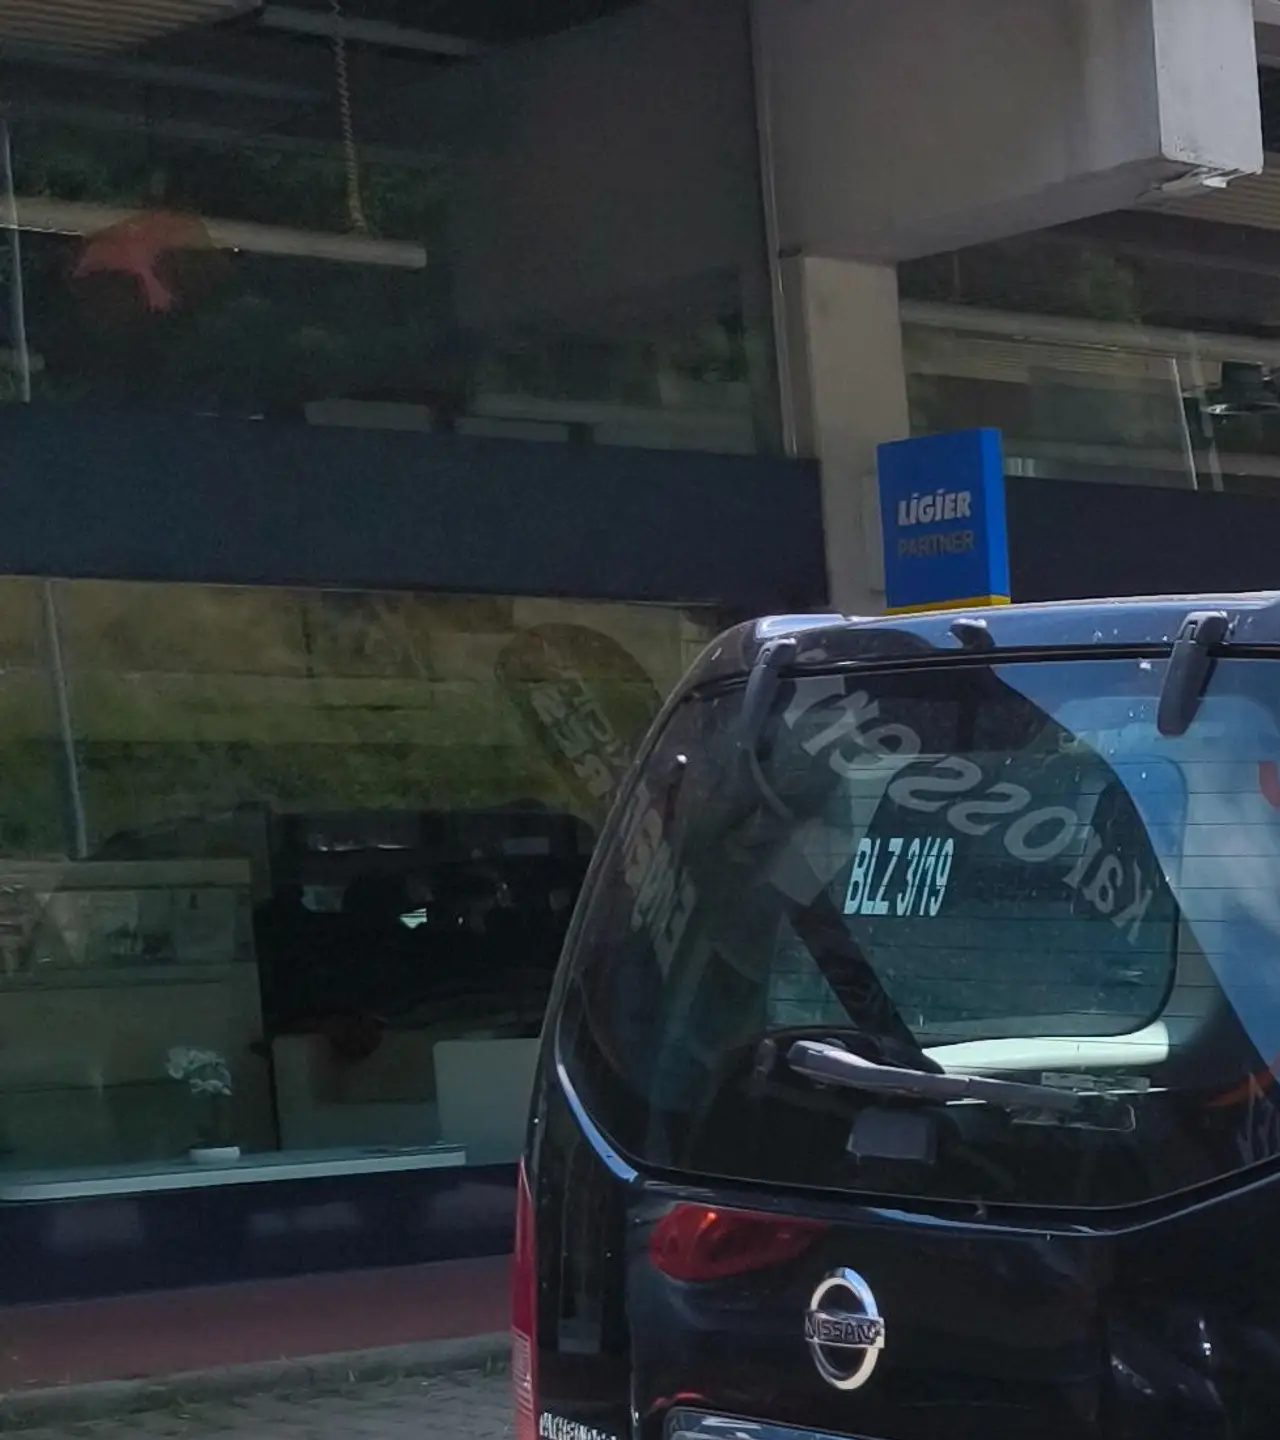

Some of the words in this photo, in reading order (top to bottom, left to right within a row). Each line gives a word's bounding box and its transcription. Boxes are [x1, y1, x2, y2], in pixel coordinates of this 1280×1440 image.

[898, 530, 975, 558] PARTNER
[843, 837, 904, 915] BLZ
[896, 835, 955, 917] 3/19
[804, 1315, 878, 1347] NISSAN
